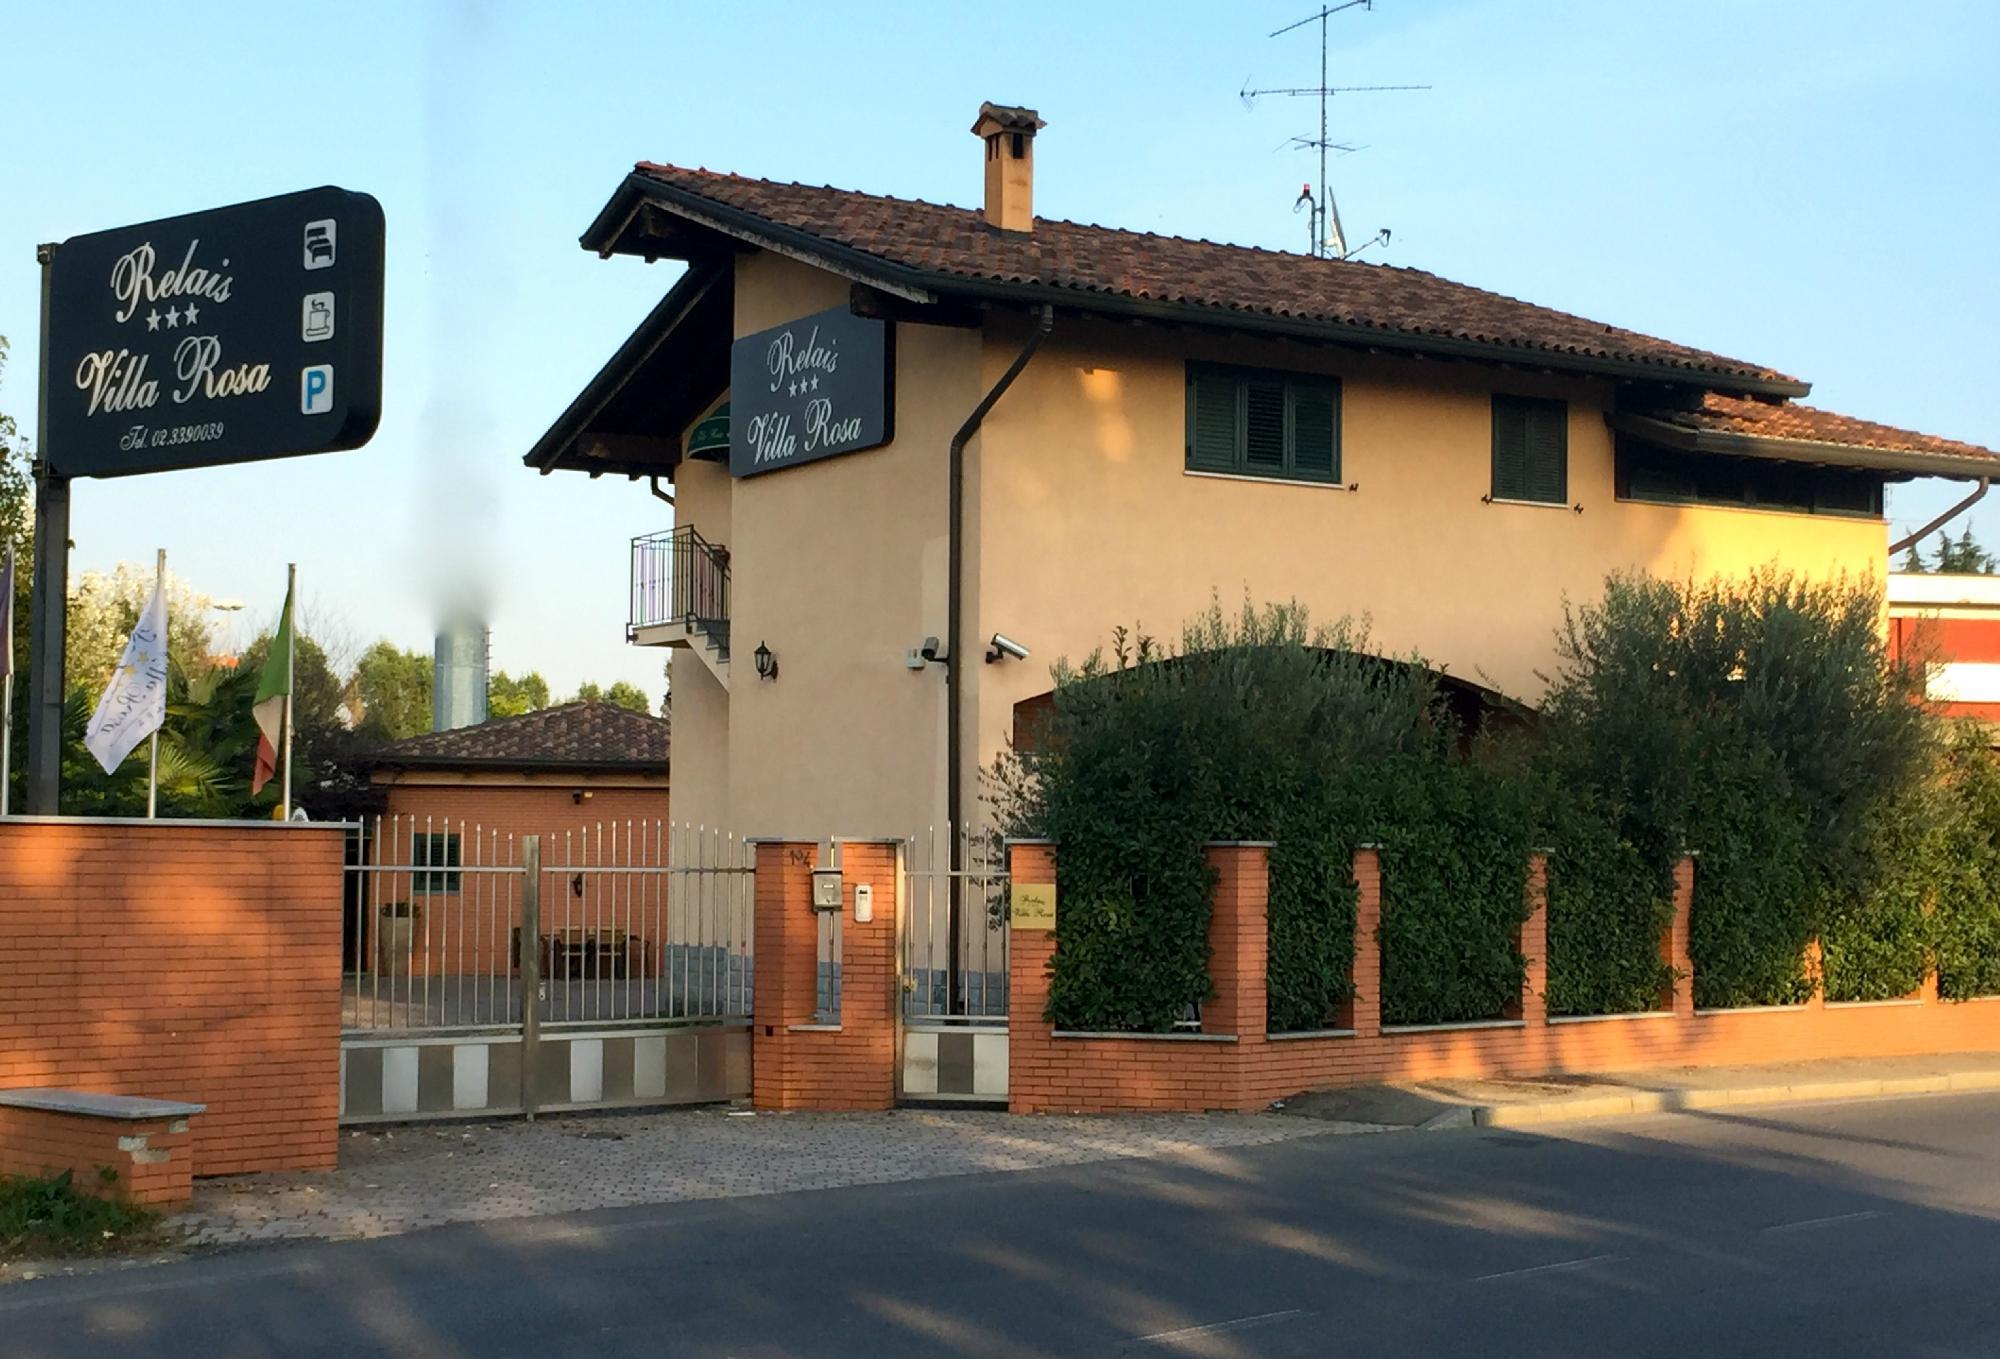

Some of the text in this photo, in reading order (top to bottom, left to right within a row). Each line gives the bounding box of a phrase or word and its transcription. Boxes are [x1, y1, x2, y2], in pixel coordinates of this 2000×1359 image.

[111, 240, 233, 323] Relais
[76, 335, 271, 416] Villa Rosa
[306, 371, 326, 410] P
[767, 325, 839, 392] Relais
[151, 422, 224, 447] 02.3390039
[747, 398, 862, 465] Villa Rosa
